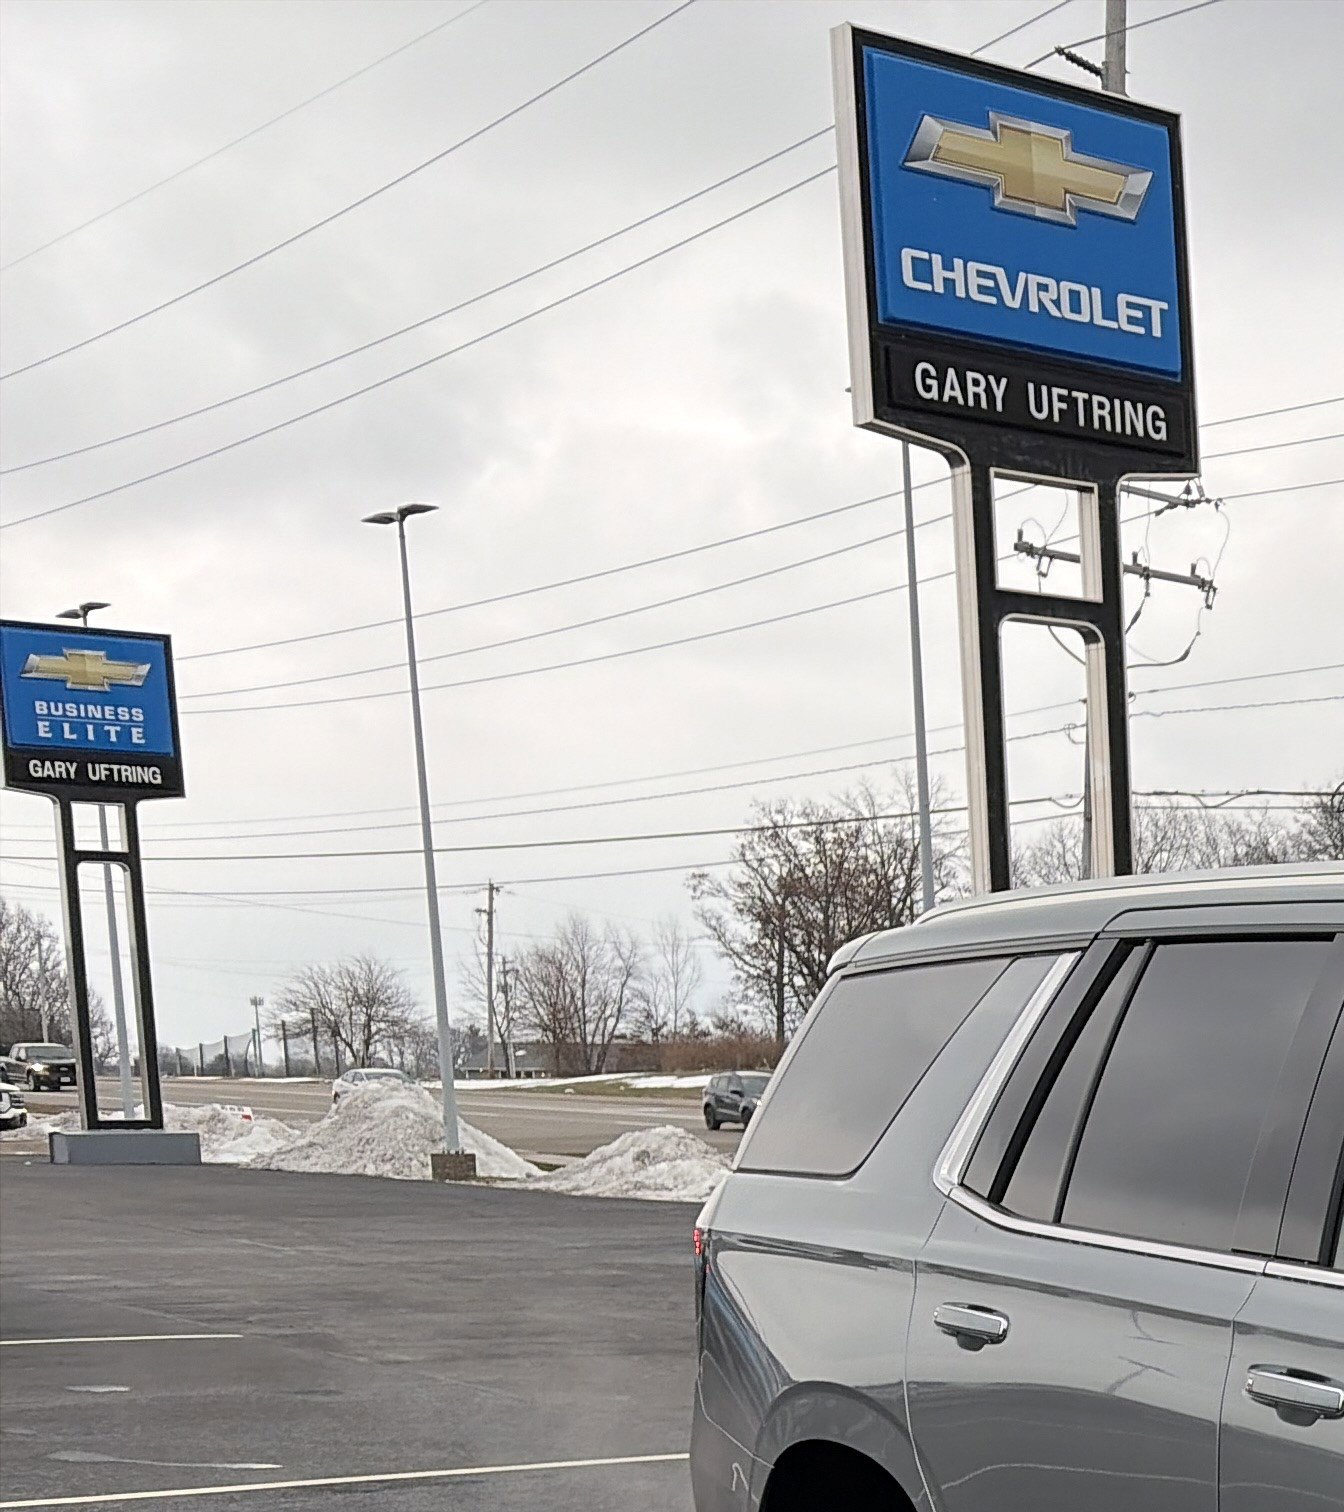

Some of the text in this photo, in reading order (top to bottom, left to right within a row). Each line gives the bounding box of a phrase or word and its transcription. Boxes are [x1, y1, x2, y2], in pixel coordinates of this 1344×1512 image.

[901, 247, 1169, 339] CHEVROLET
[914, 361, 1168, 442] GARY UFTRING
[34, 700, 145, 722] BUSINESS
[36, 720, 146, 744] ELITE
[28, 759, 162, 785] GARY UFTRING
